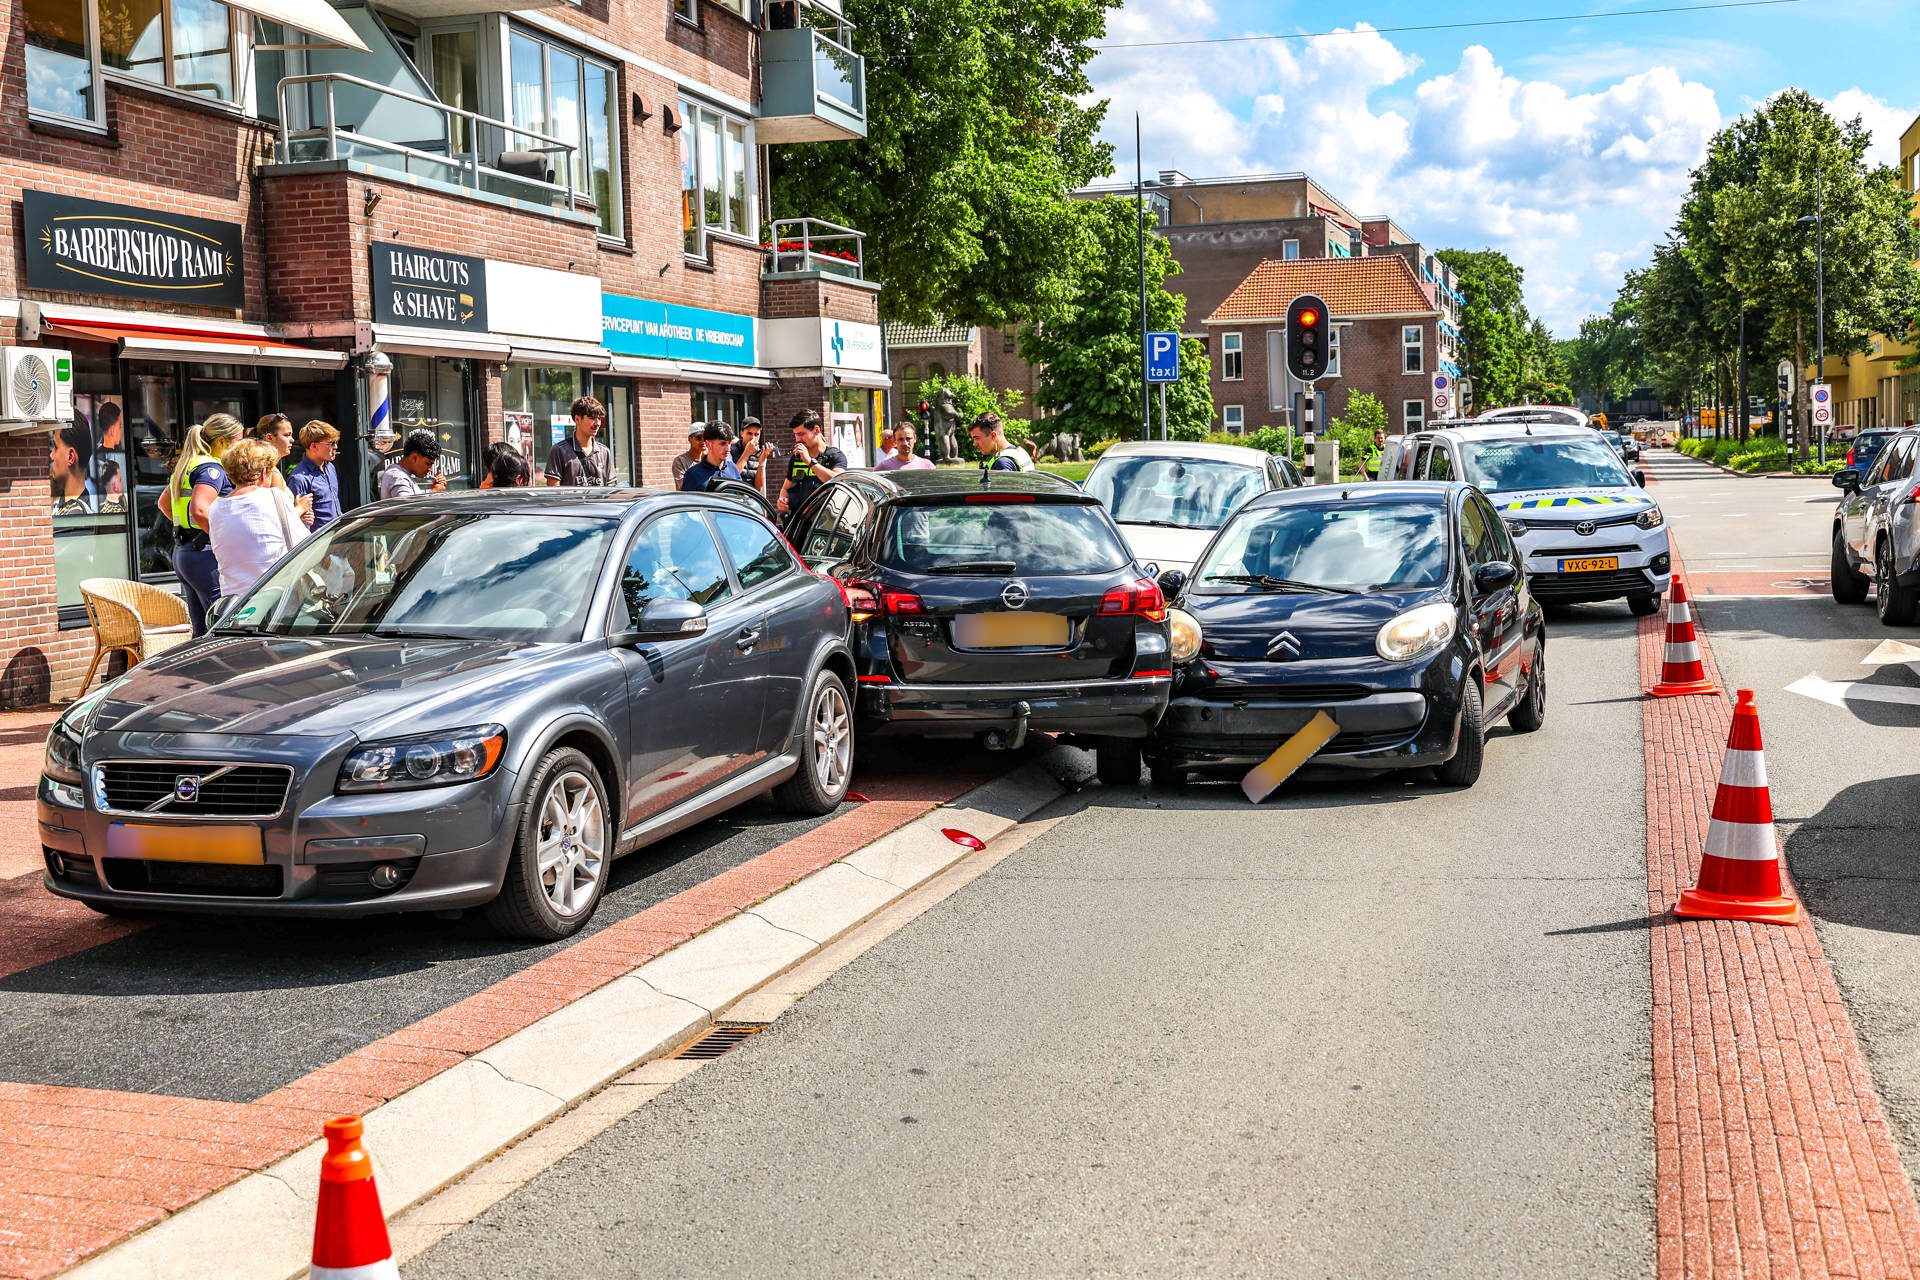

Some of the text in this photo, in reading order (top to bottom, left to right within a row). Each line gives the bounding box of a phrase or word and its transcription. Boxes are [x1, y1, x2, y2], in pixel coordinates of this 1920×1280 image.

[54, 227, 223, 279] BARBERSHOP RAMI
[390, 251, 469, 286] HAIRCUTS
[392, 290, 457, 321] & SHAVE
[602, 315, 744, 348] ERVICEPUNT VAN APOTHEEK DE VRIENDSCHAP
[1153, 336, 1171, 361] P
[1150, 366, 1176, 377] taxi
[440, 454, 461, 475] RAMI
[1567, 559, 1614, 571] VXG-92-L
